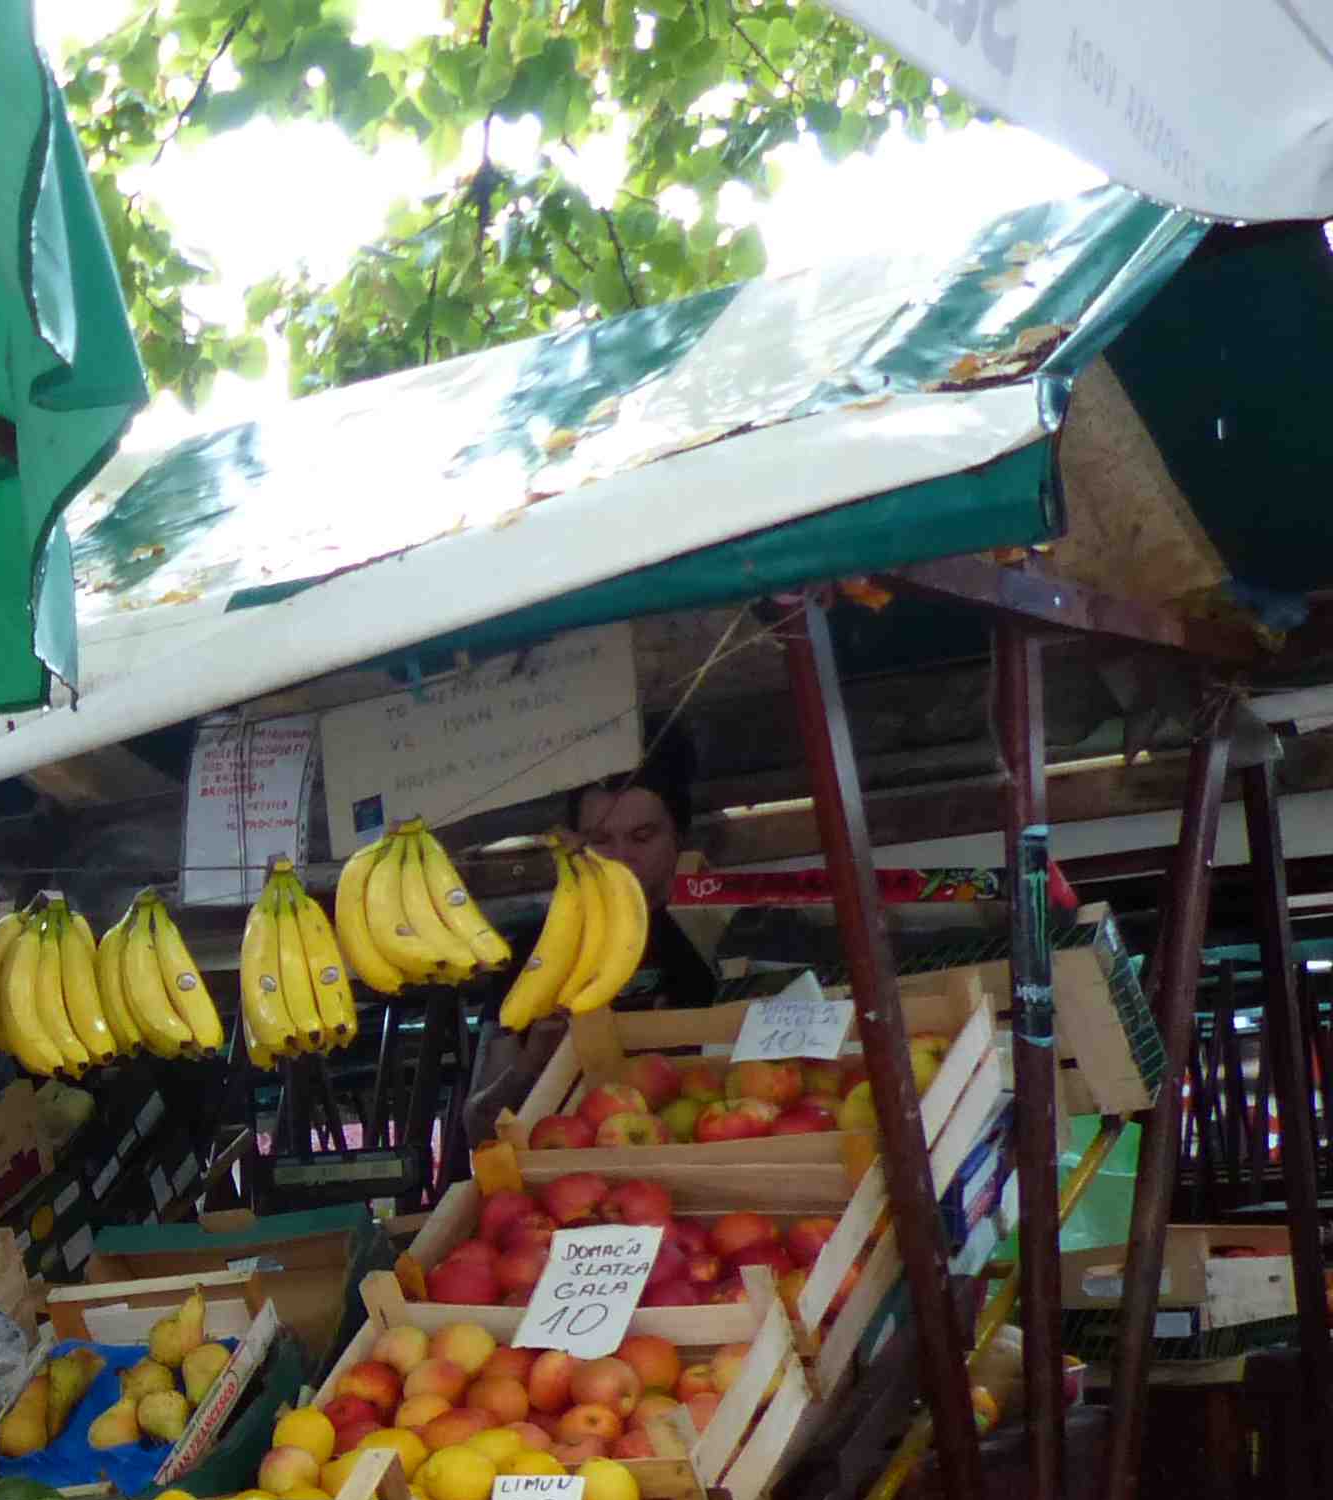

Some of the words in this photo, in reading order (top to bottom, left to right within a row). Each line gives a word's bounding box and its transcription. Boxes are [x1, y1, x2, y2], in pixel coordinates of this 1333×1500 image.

[570, 1261, 650, 1276] SLATKA
[554, 1281, 629, 1300] GALA
[540, 1303, 609, 1336] 10
